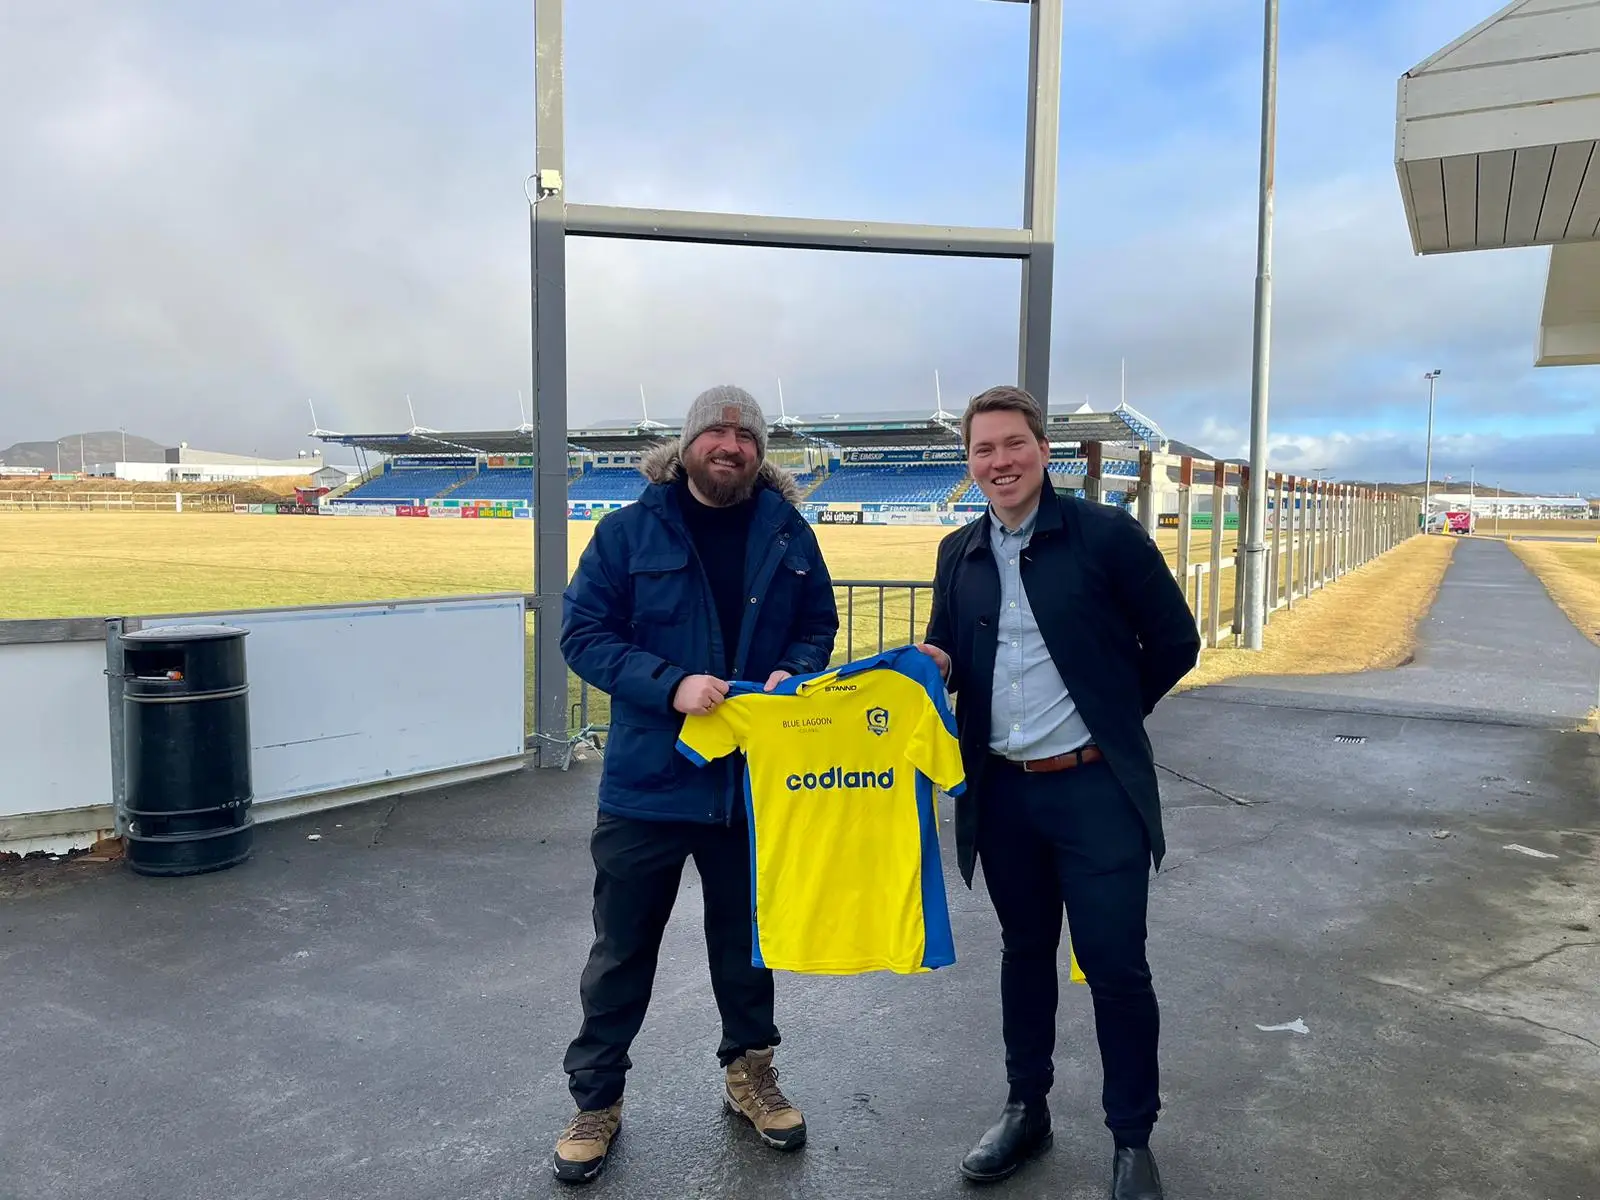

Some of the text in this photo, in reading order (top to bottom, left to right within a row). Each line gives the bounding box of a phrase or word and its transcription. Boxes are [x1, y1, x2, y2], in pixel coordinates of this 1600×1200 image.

[782, 717, 832, 728] BLUE LAGOON
[785, 766, 895, 792] codland
